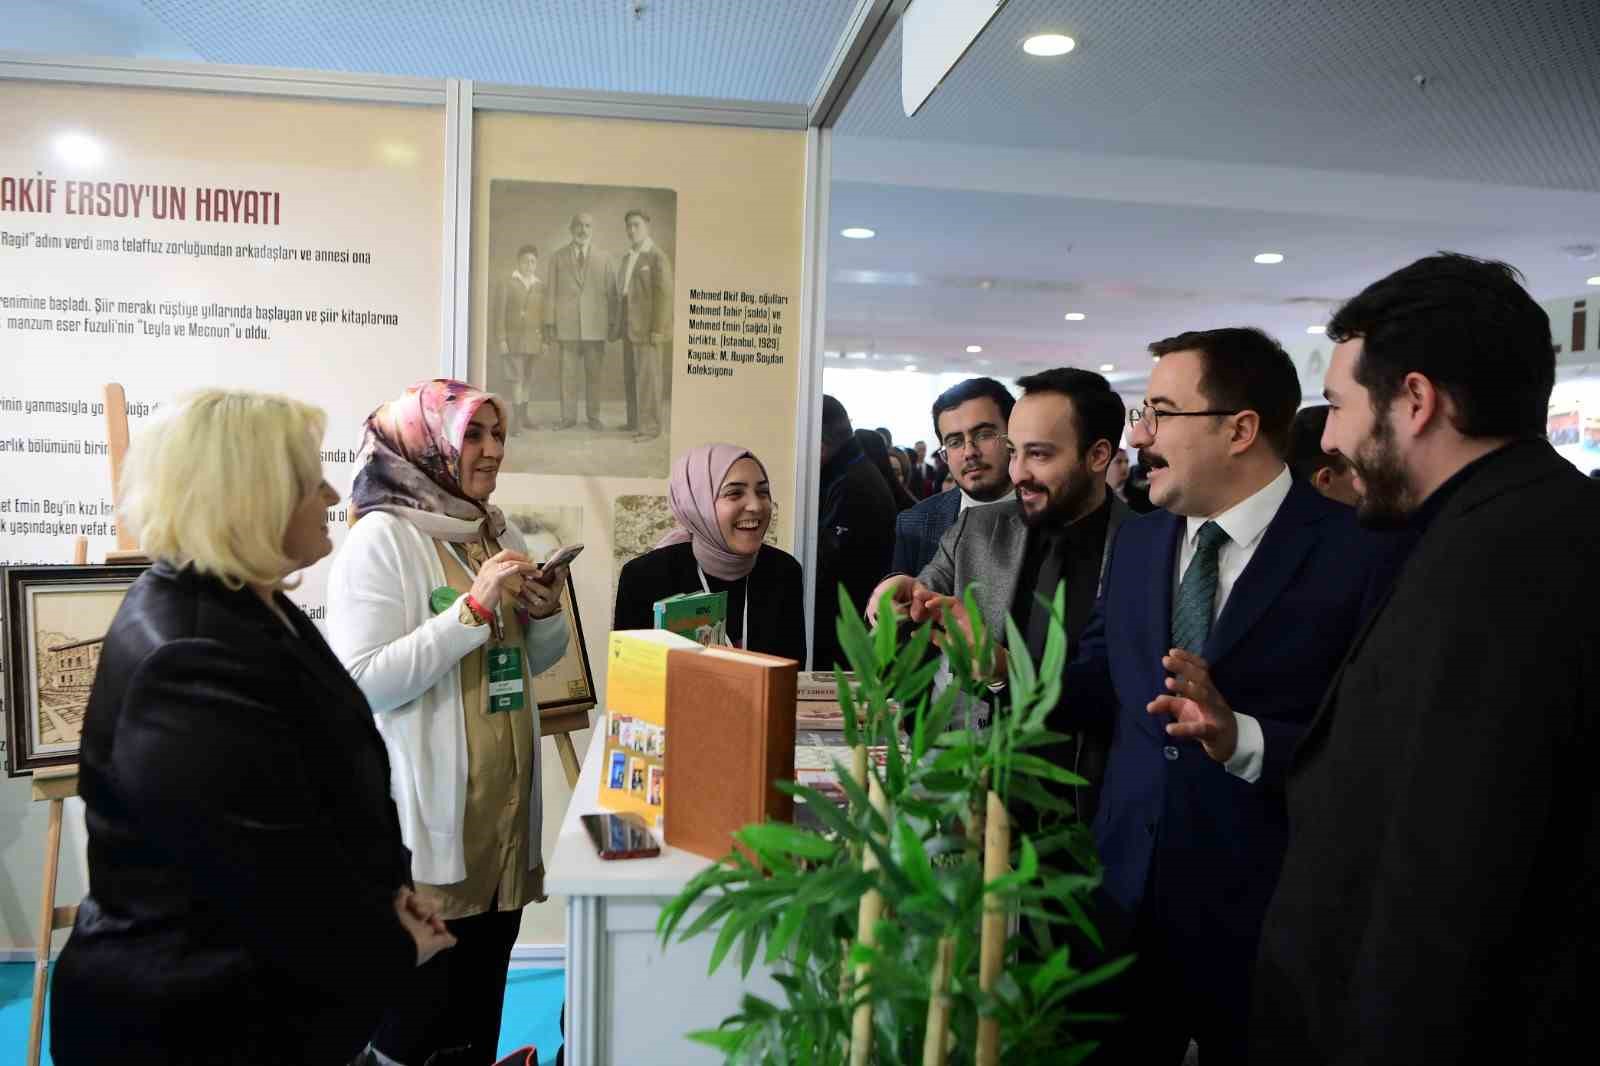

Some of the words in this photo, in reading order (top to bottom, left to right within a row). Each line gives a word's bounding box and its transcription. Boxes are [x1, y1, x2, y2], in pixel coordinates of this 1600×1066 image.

[1, 171, 57, 213] AKİF
[65, 180, 186, 220] ERSOY'UN
[196, 187, 280, 225] HAYATI
[65, 235, 94, 250] verdi
[96, 239, 119, 251] ama
[122, 236, 163, 254] telaffuz
[166, 239, 233, 258] zorluğundan
[235, 243, 297, 261] arkadaşları
[300, 249, 312, 261] ve
[315, 249, 349, 263] annesi
[352, 251, 371, 264] ona
[689, 289, 721, 302] Mehmed
[759, 293, 788, 305] oğulları
[95, 297, 115, 315] Şiir
[118, 299, 156, 315] merakı
[159, 300, 198, 319] rüştiye
[201, 303, 252, 320] yıllarında
[255, 305, 302, 323] başlayan
[305, 309, 317, 321] ve
[320, 307, 339, 325] şiir
[341, 308, 398, 326] kitaplarına
[689, 304, 721, 318] Mehmed
[7, 317, 53, 330] manzum
[56, 319, 81, 332] eser
[174, 324, 185, 336] ve
[245, 325, 271, 340] oldu.
[688, 319, 720, 332] Mehmed
[722, 320, 740, 332] Emin
[25, 399, 88, 415] yanmasıyla
[28, 438, 81, 454] bölümünü
[15, 498, 40, 513] Emin
[79, 501, 98, 515] kızı
[9, 520, 78, 536] yaşındayken
[80, 521, 107, 536] vefat
